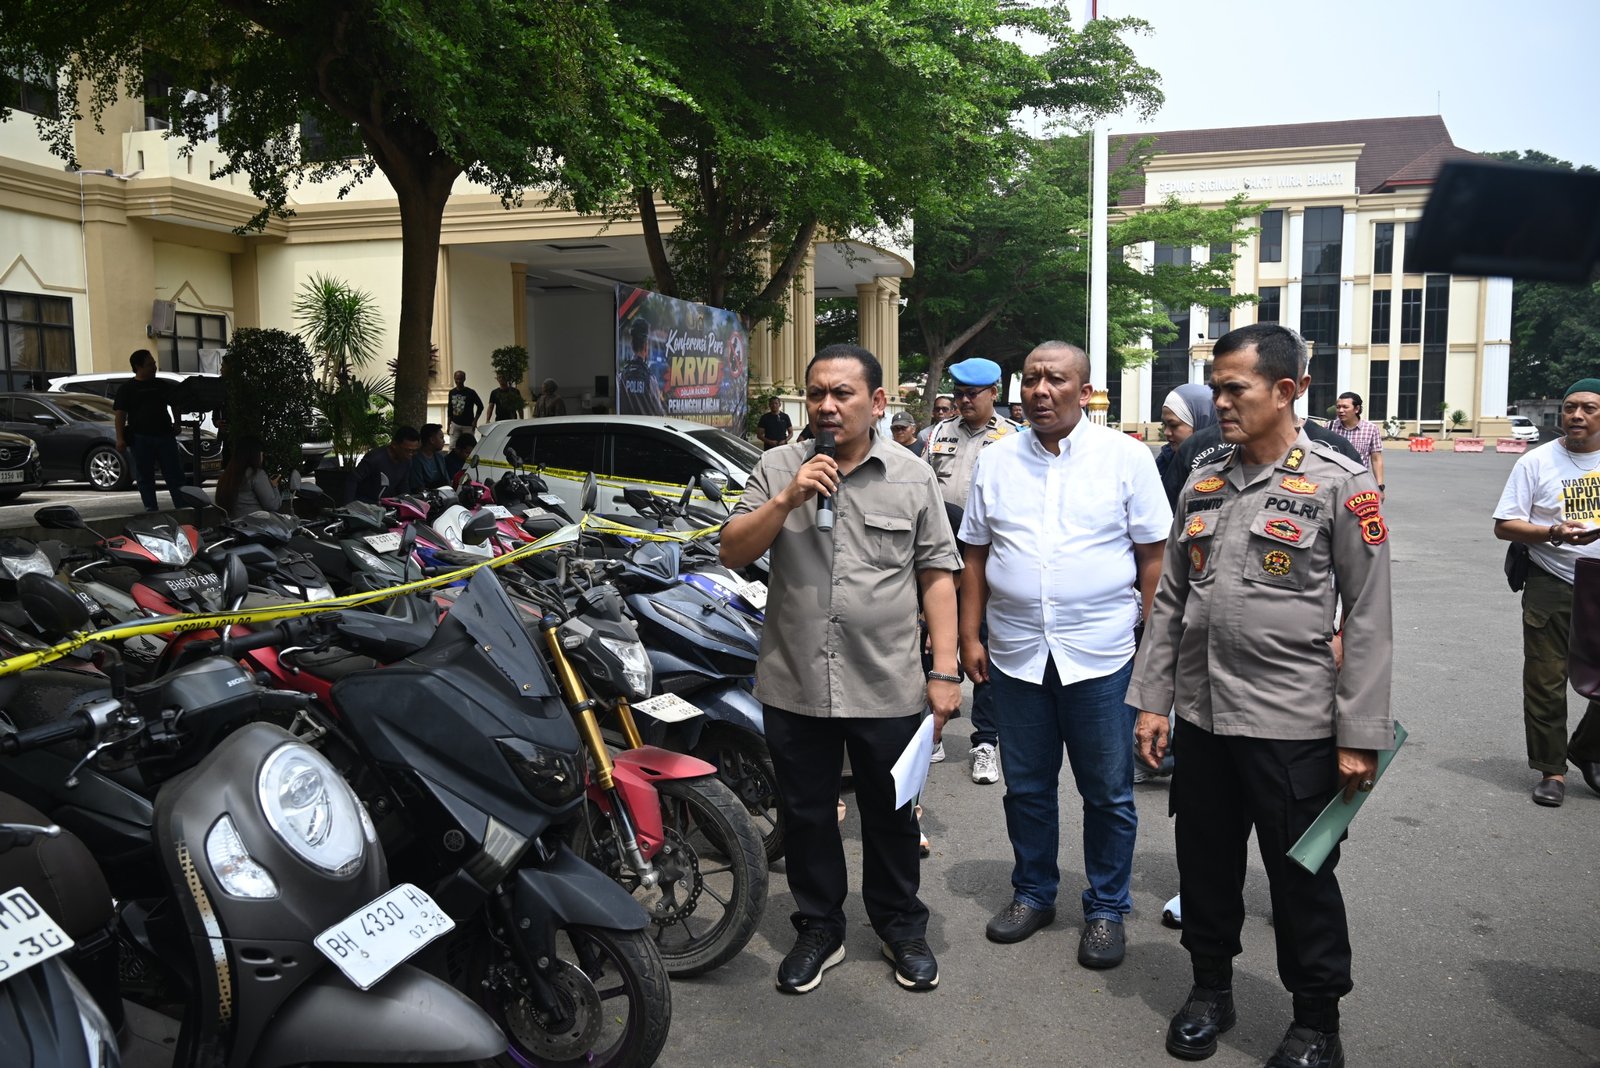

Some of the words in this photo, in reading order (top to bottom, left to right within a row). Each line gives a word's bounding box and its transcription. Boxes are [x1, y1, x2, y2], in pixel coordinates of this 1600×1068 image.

[1157, 180, 1196, 193] GEDUNG
[1277, 175, 1302, 188] WIRA
[1307, 172, 1343, 187] BHAKTI
[665, 329, 707, 358] Konferensi
[707, 332, 724, 355] Pers
[671, 357, 718, 386] KRYD
[1264, 496, 1319, 519] POLRI
[1349, 493, 1377, 507] POLDA
[1565, 511, 1594, 520] POLDA
[326, 931, 359, 959] BH
[360, 901, 404, 937] 4330
